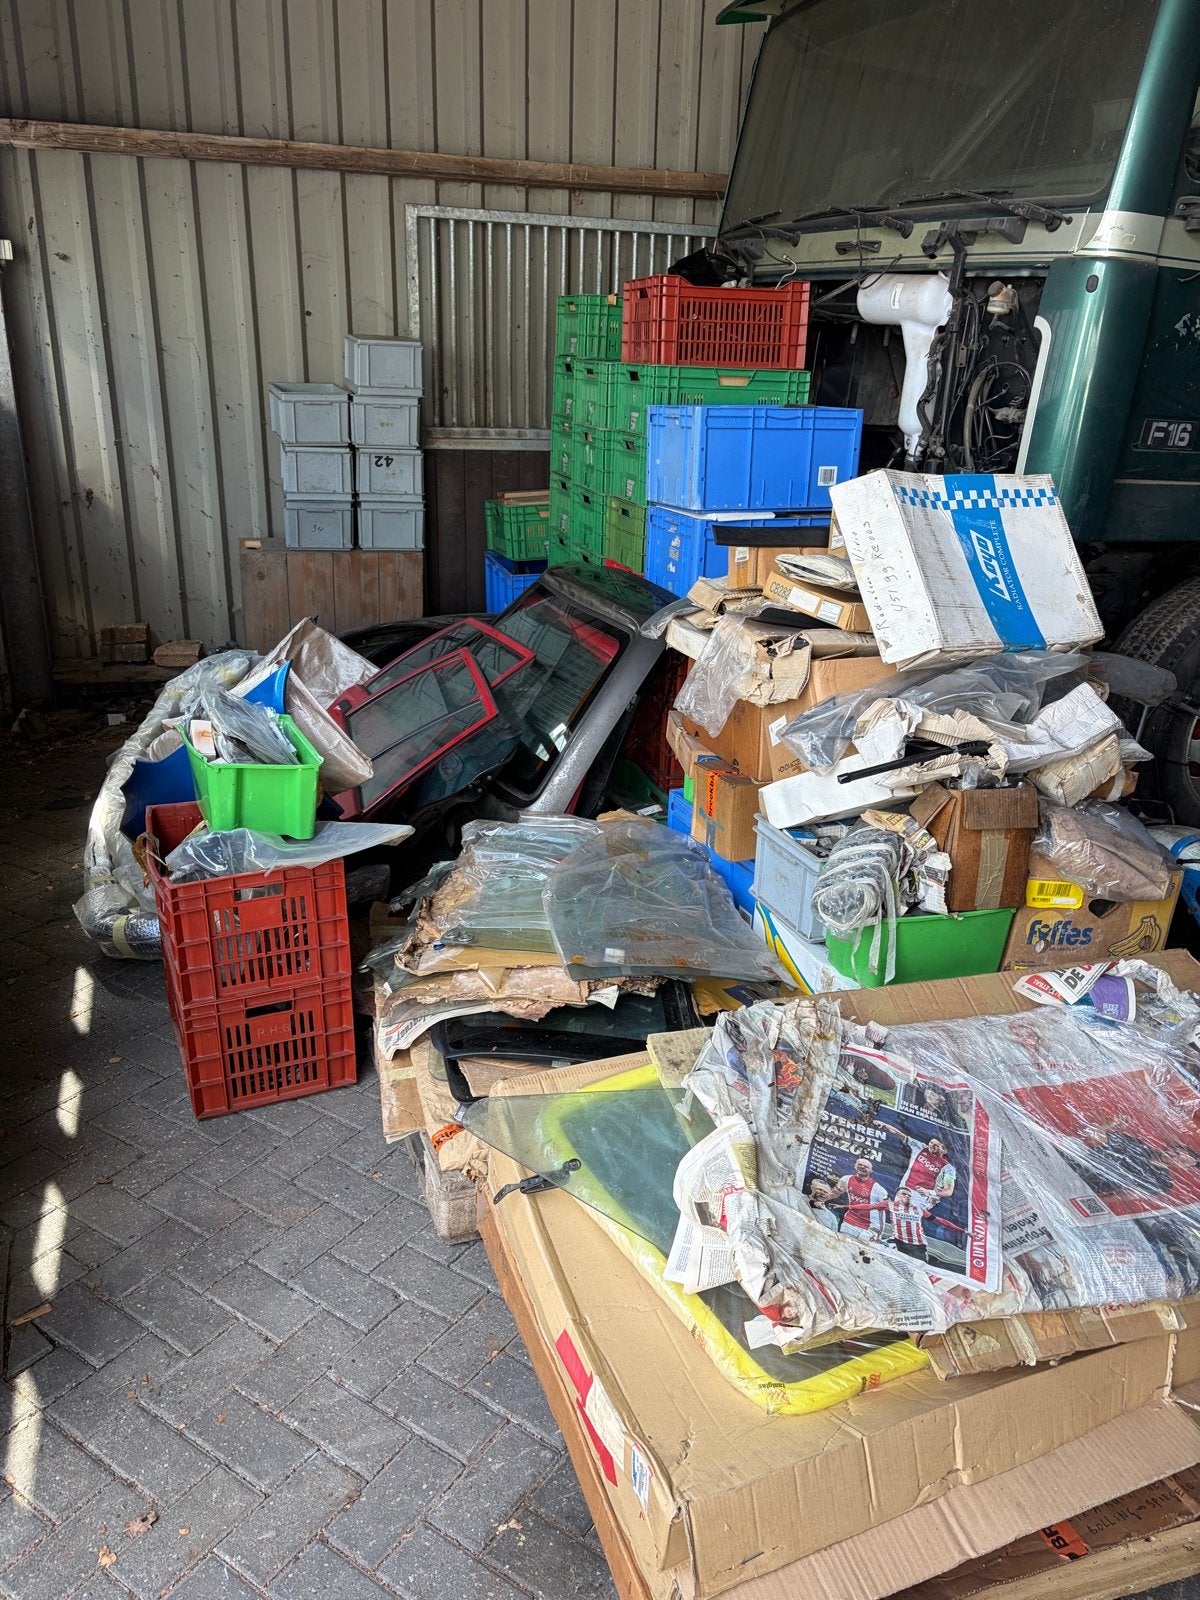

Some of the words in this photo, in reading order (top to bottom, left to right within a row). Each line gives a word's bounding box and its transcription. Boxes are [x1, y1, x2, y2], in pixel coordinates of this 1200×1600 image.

[1147, 422, 1192, 446] F16
[374, 456, 394, 467] 42
[990, 520, 1006, 565] COMPLETE
[1003, 568, 1023, 609] RADIATOR
[1064, 970, 1084, 989] DE
[900, 1106, 915, 1114] VAN
[819, 1122, 851, 1140] VAN
[854, 1132, 881, 1148] DIT
[821, 1110, 887, 1140] STERREN
